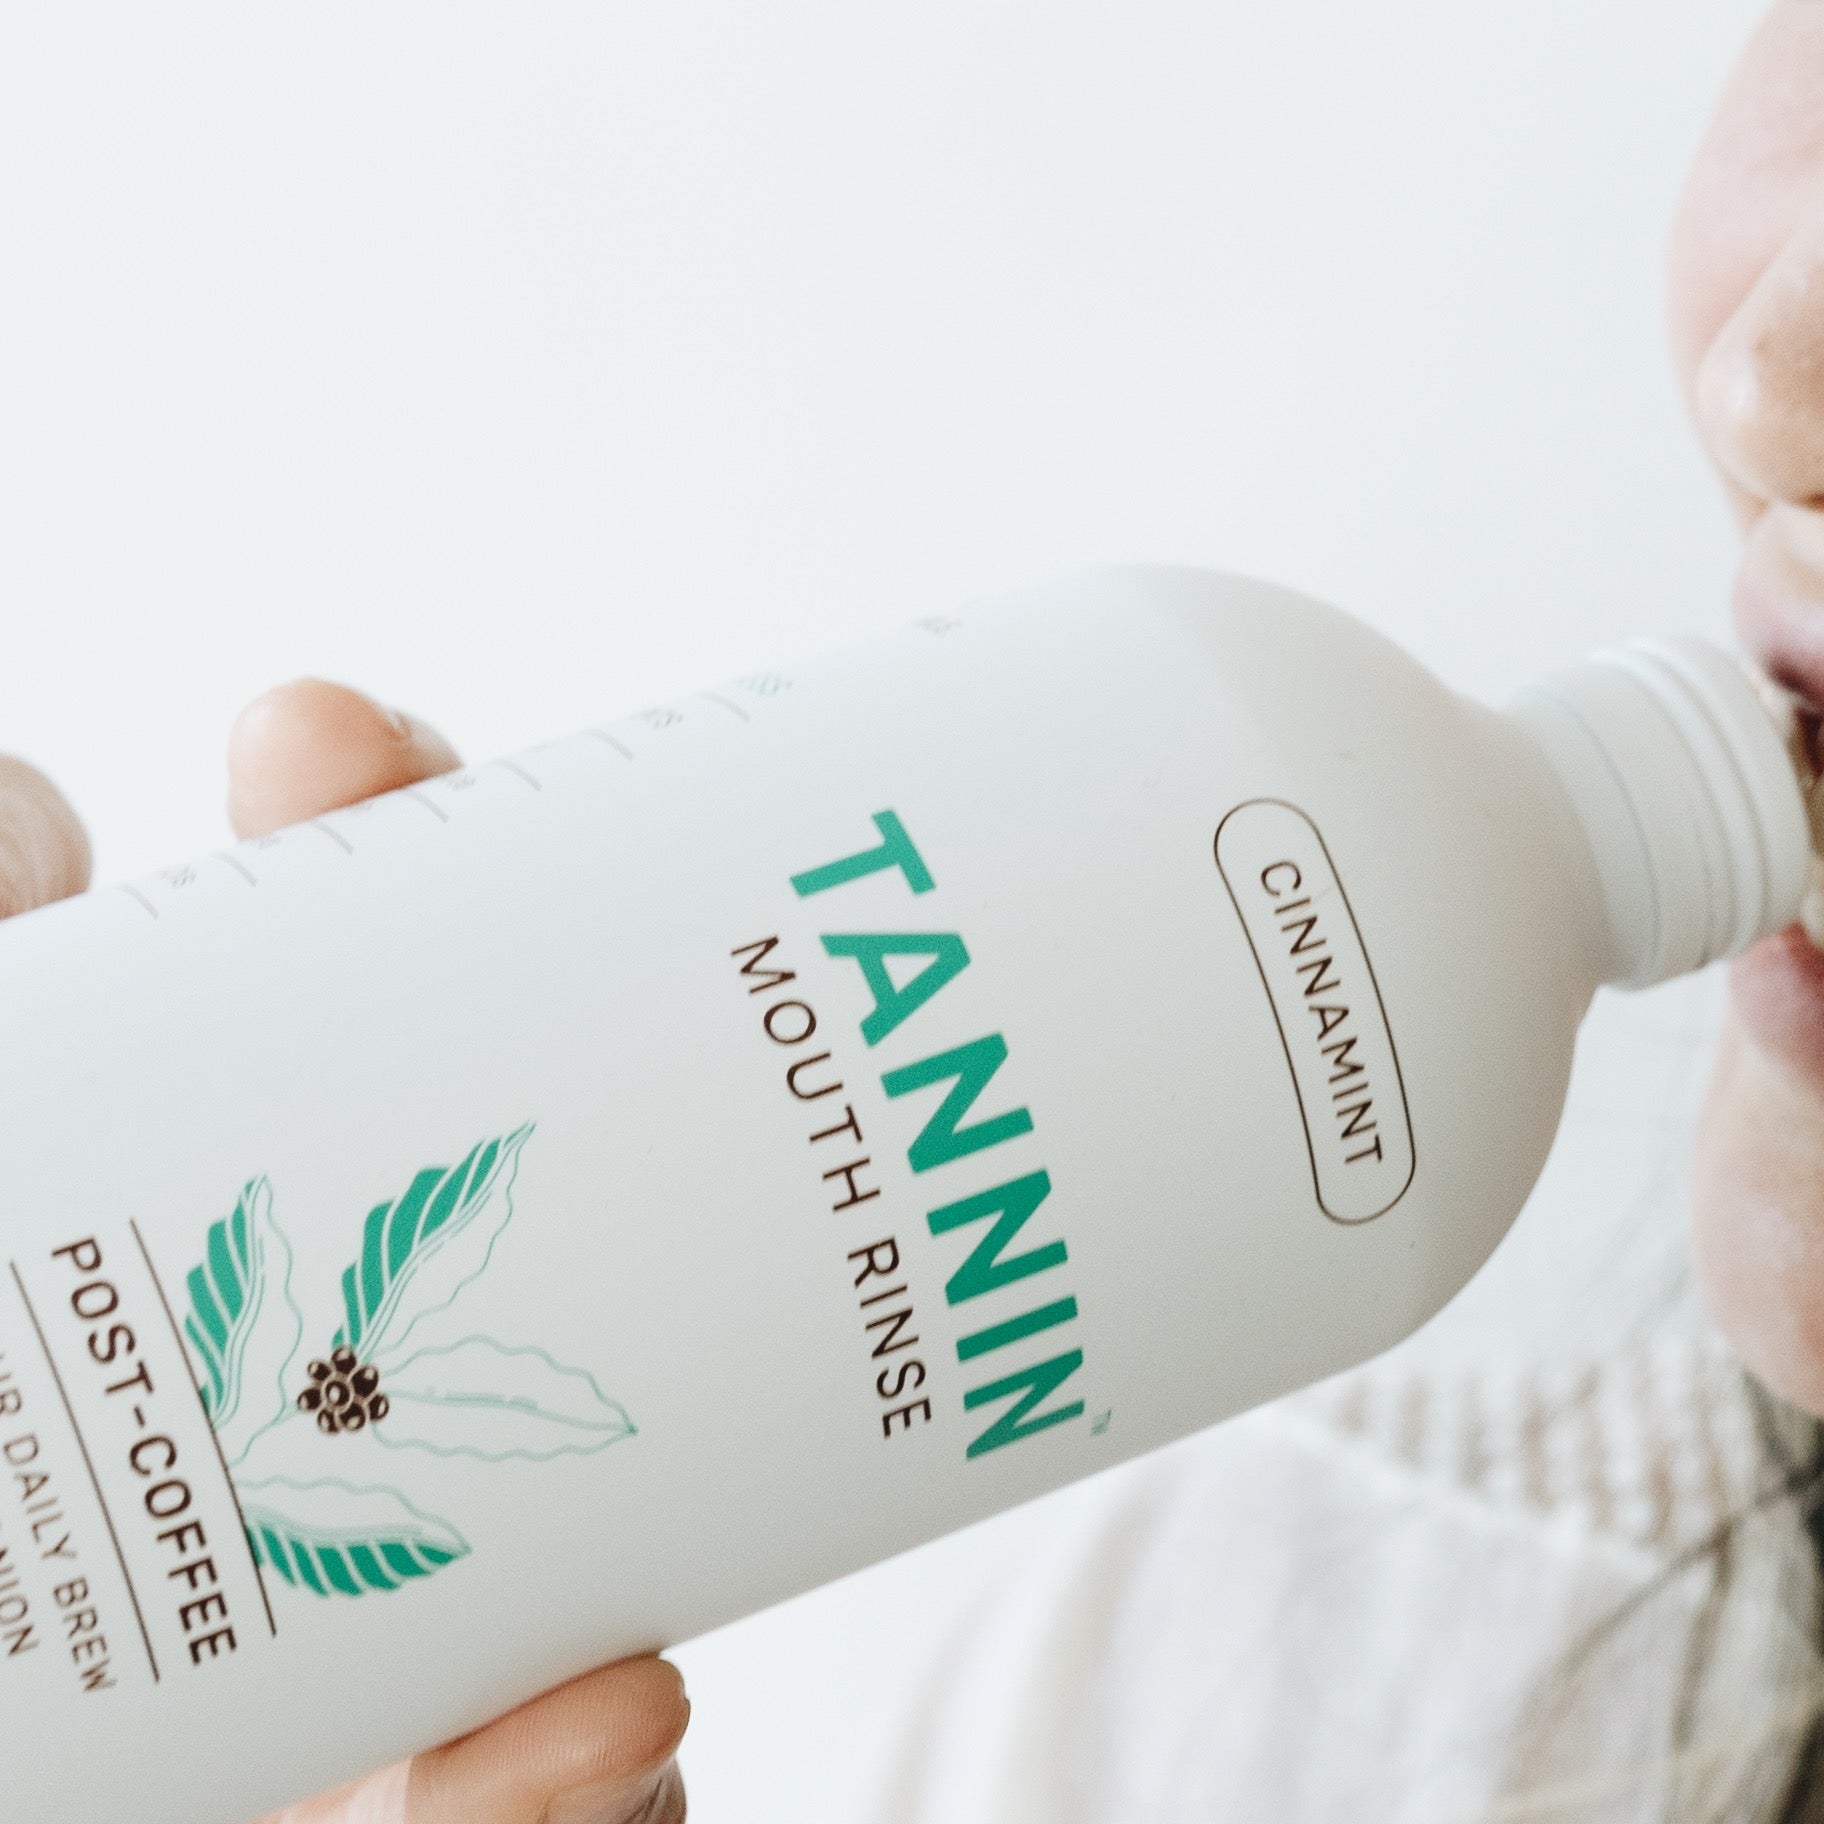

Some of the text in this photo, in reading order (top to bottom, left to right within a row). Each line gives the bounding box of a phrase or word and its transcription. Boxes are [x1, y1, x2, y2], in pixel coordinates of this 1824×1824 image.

[730, 935, 932, 1440] MOUTH RINSE
[789, 808, 1086, 1462] TANNIN
[1261, 860, 1384, 1165] CINNAMINT
[3, 1433, 78, 1560] DAILY
[53, 1576, 117, 1693] BREW
[51, 1236, 238, 1667] POST-COFFEE
